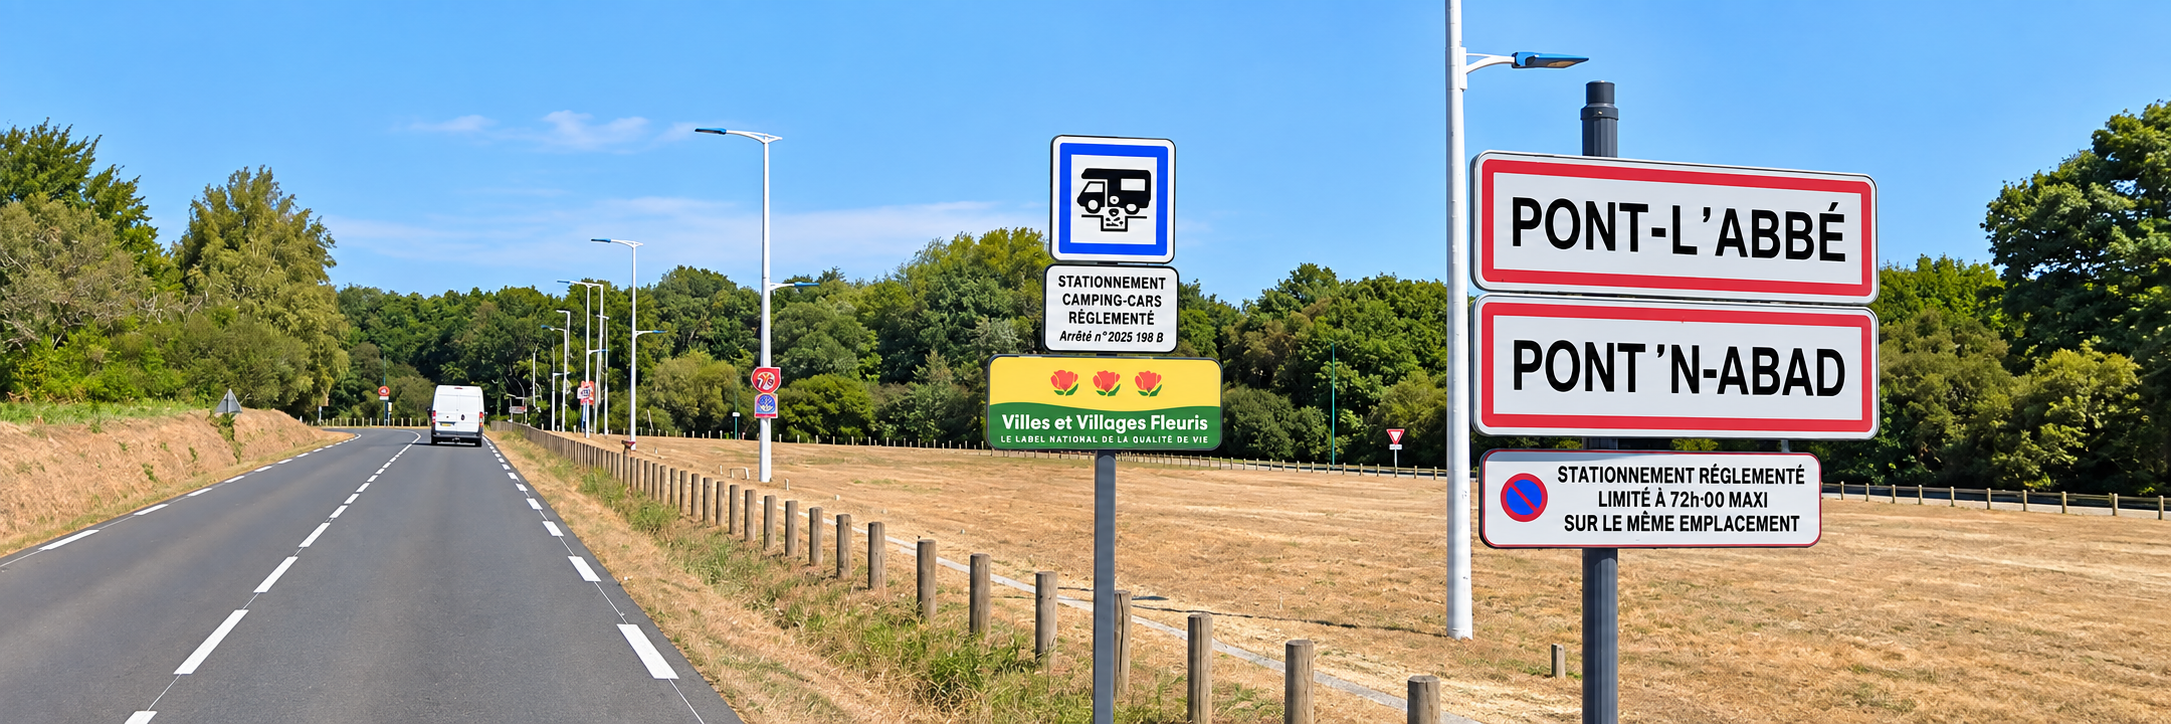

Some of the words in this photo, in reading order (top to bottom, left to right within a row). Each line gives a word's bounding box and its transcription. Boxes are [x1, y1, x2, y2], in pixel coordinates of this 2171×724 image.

[1511, 196, 1846, 262] PONT-L'ABBÉ
[1058, 275, 1166, 290] STATIONNEMENT
[1062, 293, 1162, 307] CAMPING-CARS
[1136, 332, 1154, 343] 198
[1156, 332, 1164, 343] B
[1001, 414, 1051, 430] Villes
[1054, 415, 1073, 430] et
[1076, 414, 1147, 434] Villages
[1150, 414, 1208, 430] Fleuris
[1000, 435, 1012, 443] LE
[1015, 435, 1046, 443] LABEL
[1049, 435, 1098, 443] NATIONAL
[1101, 435, 1114, 443] DE
[1117, 435, 1129, 443] LA
[1132, 434, 1173, 444] QUALITÉ
[1176, 435, 1189, 444] DE
[1192, 435, 1208, 444] VIE
[1557, 465, 1695, 483] STATIONNEMENT
[1699, 463, 1805, 485] RÉGLEMENTÉ
[1598, 486, 1651, 508] LIMITÉ
[1654, 487, 1667, 508] À
[1728, 491, 1768, 508] MAXI
[1564, 514, 1598, 532] SUR
[1602, 514, 1623, 532] LE
[1626, 510, 1675, 532] MÊME
[1679, 514, 1800, 532] EMPLACEMENT
